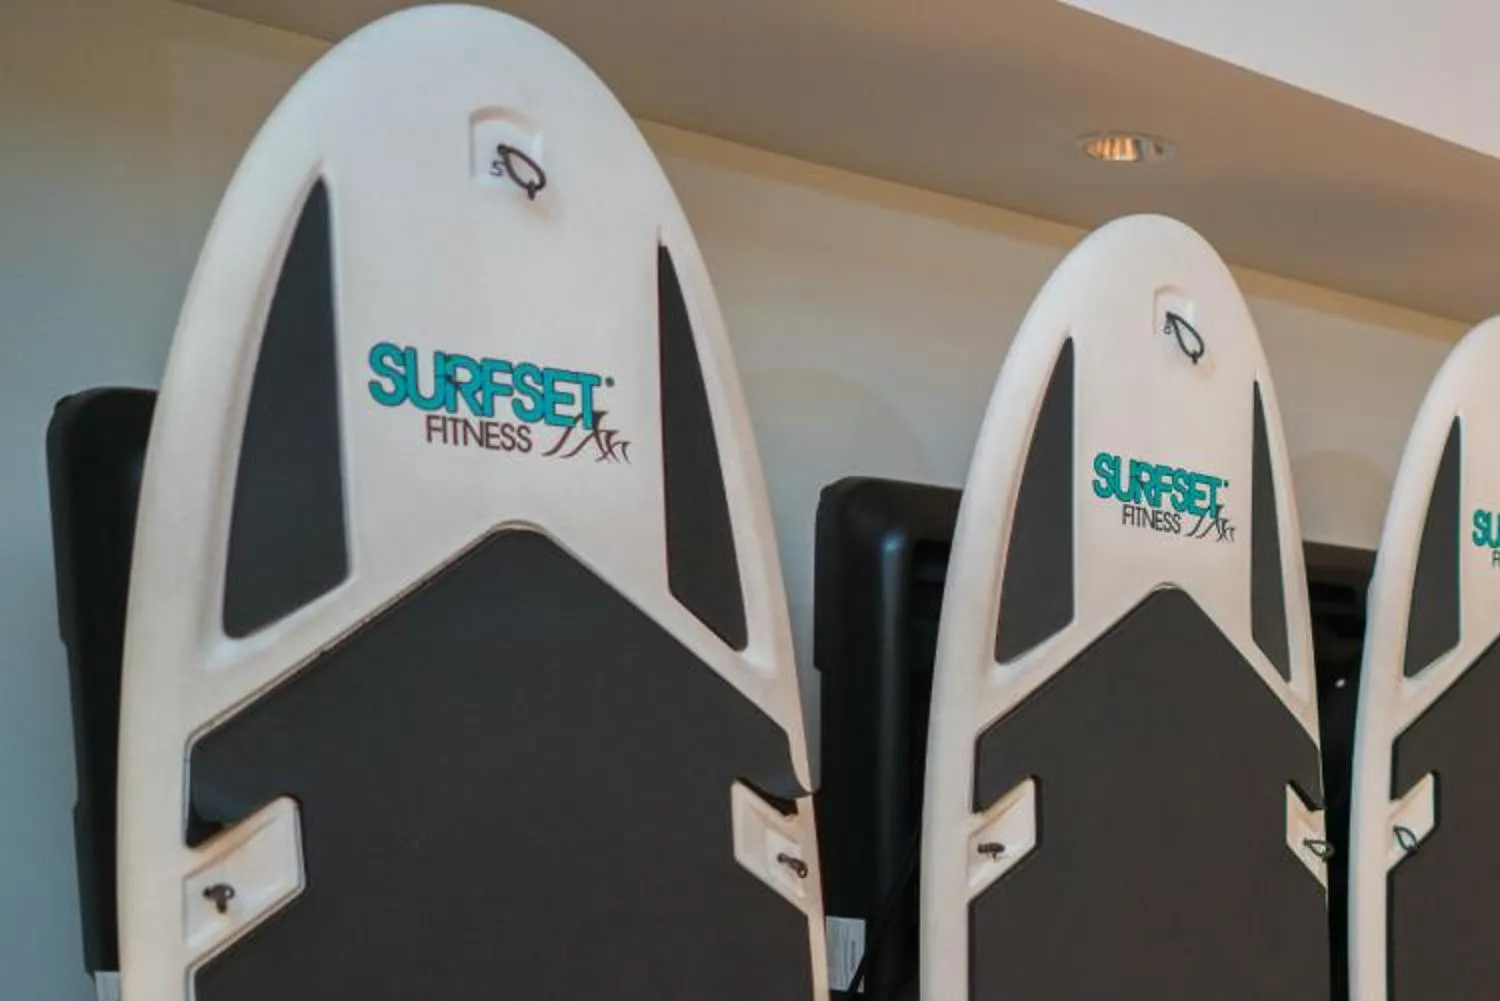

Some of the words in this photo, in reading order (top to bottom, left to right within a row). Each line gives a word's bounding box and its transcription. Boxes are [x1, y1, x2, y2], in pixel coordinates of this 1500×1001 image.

[368, 342, 602, 430] SURFSET
[426, 416, 533, 452] FITNESS
[1093, 452, 1223, 517] SURFSET
[1122, 504, 1182, 533] FITNESS
